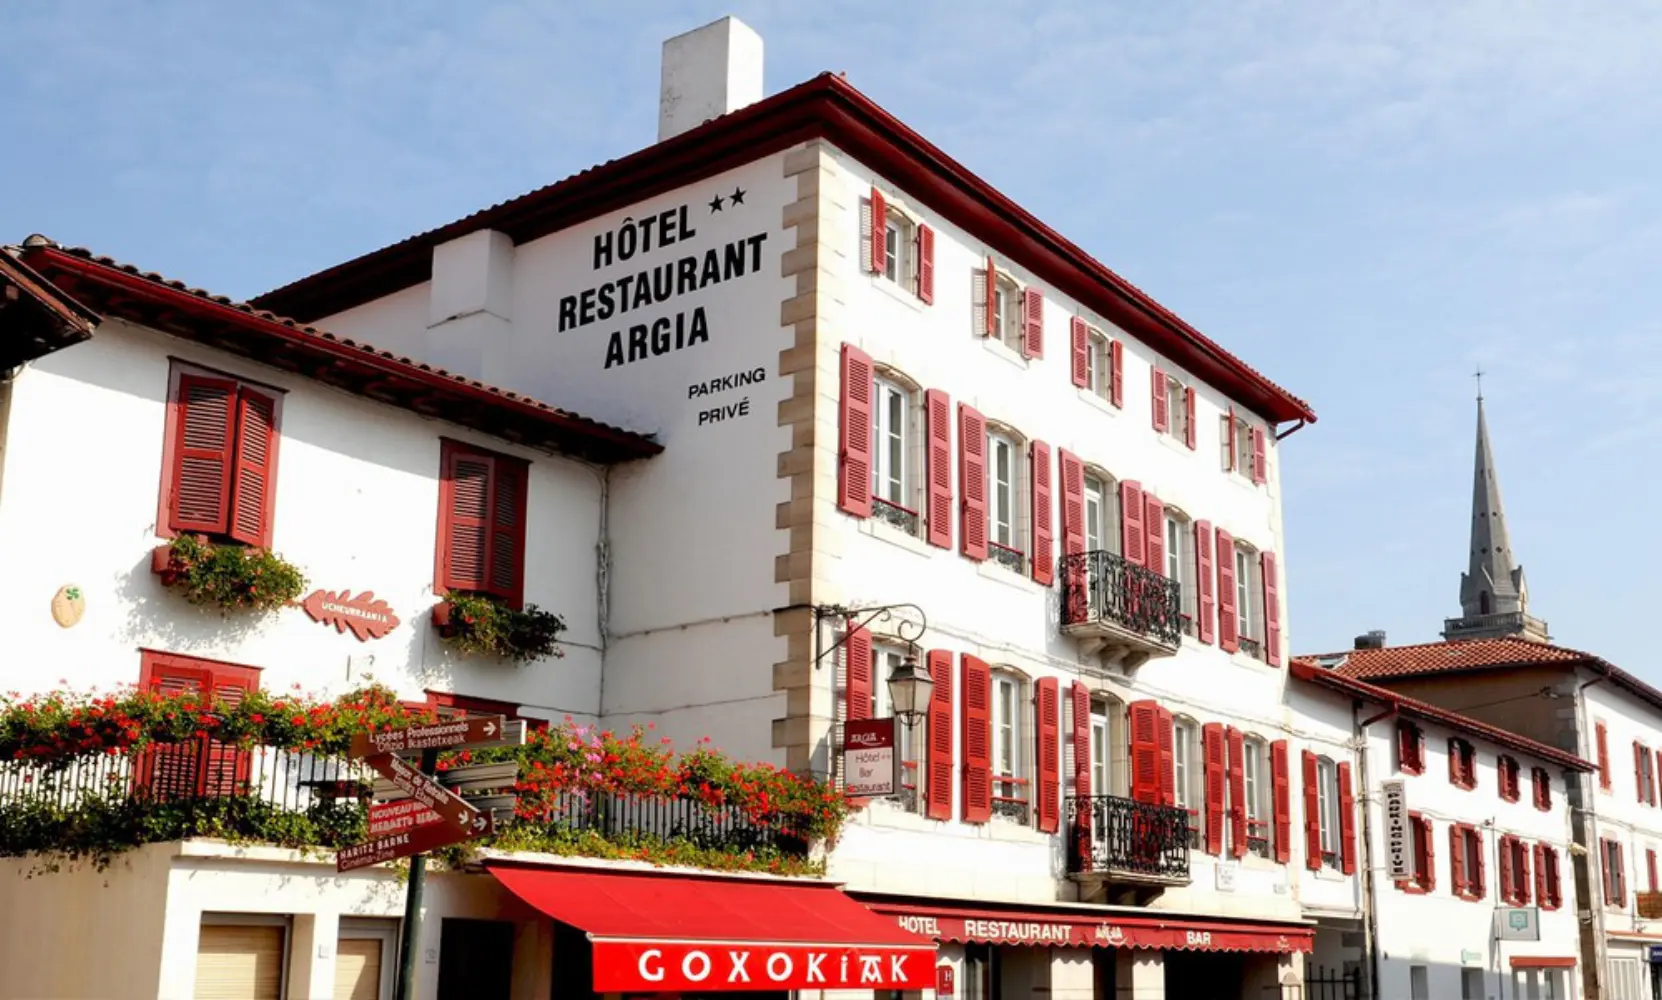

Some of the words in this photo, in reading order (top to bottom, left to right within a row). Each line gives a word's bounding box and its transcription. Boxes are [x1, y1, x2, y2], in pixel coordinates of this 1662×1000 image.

[592, 204, 696, 270] HÔTEL
[557, 232, 768, 333] RESTAURANT
[603, 306, 709, 370] ARGIA
[687, 366, 767, 400] PARKING
[698, 396, 750, 426] PRIVÉ
[407, 722, 469, 737] Professionnels
[855, 752, 880, 764] Hôtel
[858, 767, 874, 779] Bar
[898, 914, 942, 935] HOTEL
[964, 919, 1072, 942] RESTAURANT
[1186, 930, 1212, 946] BAR
